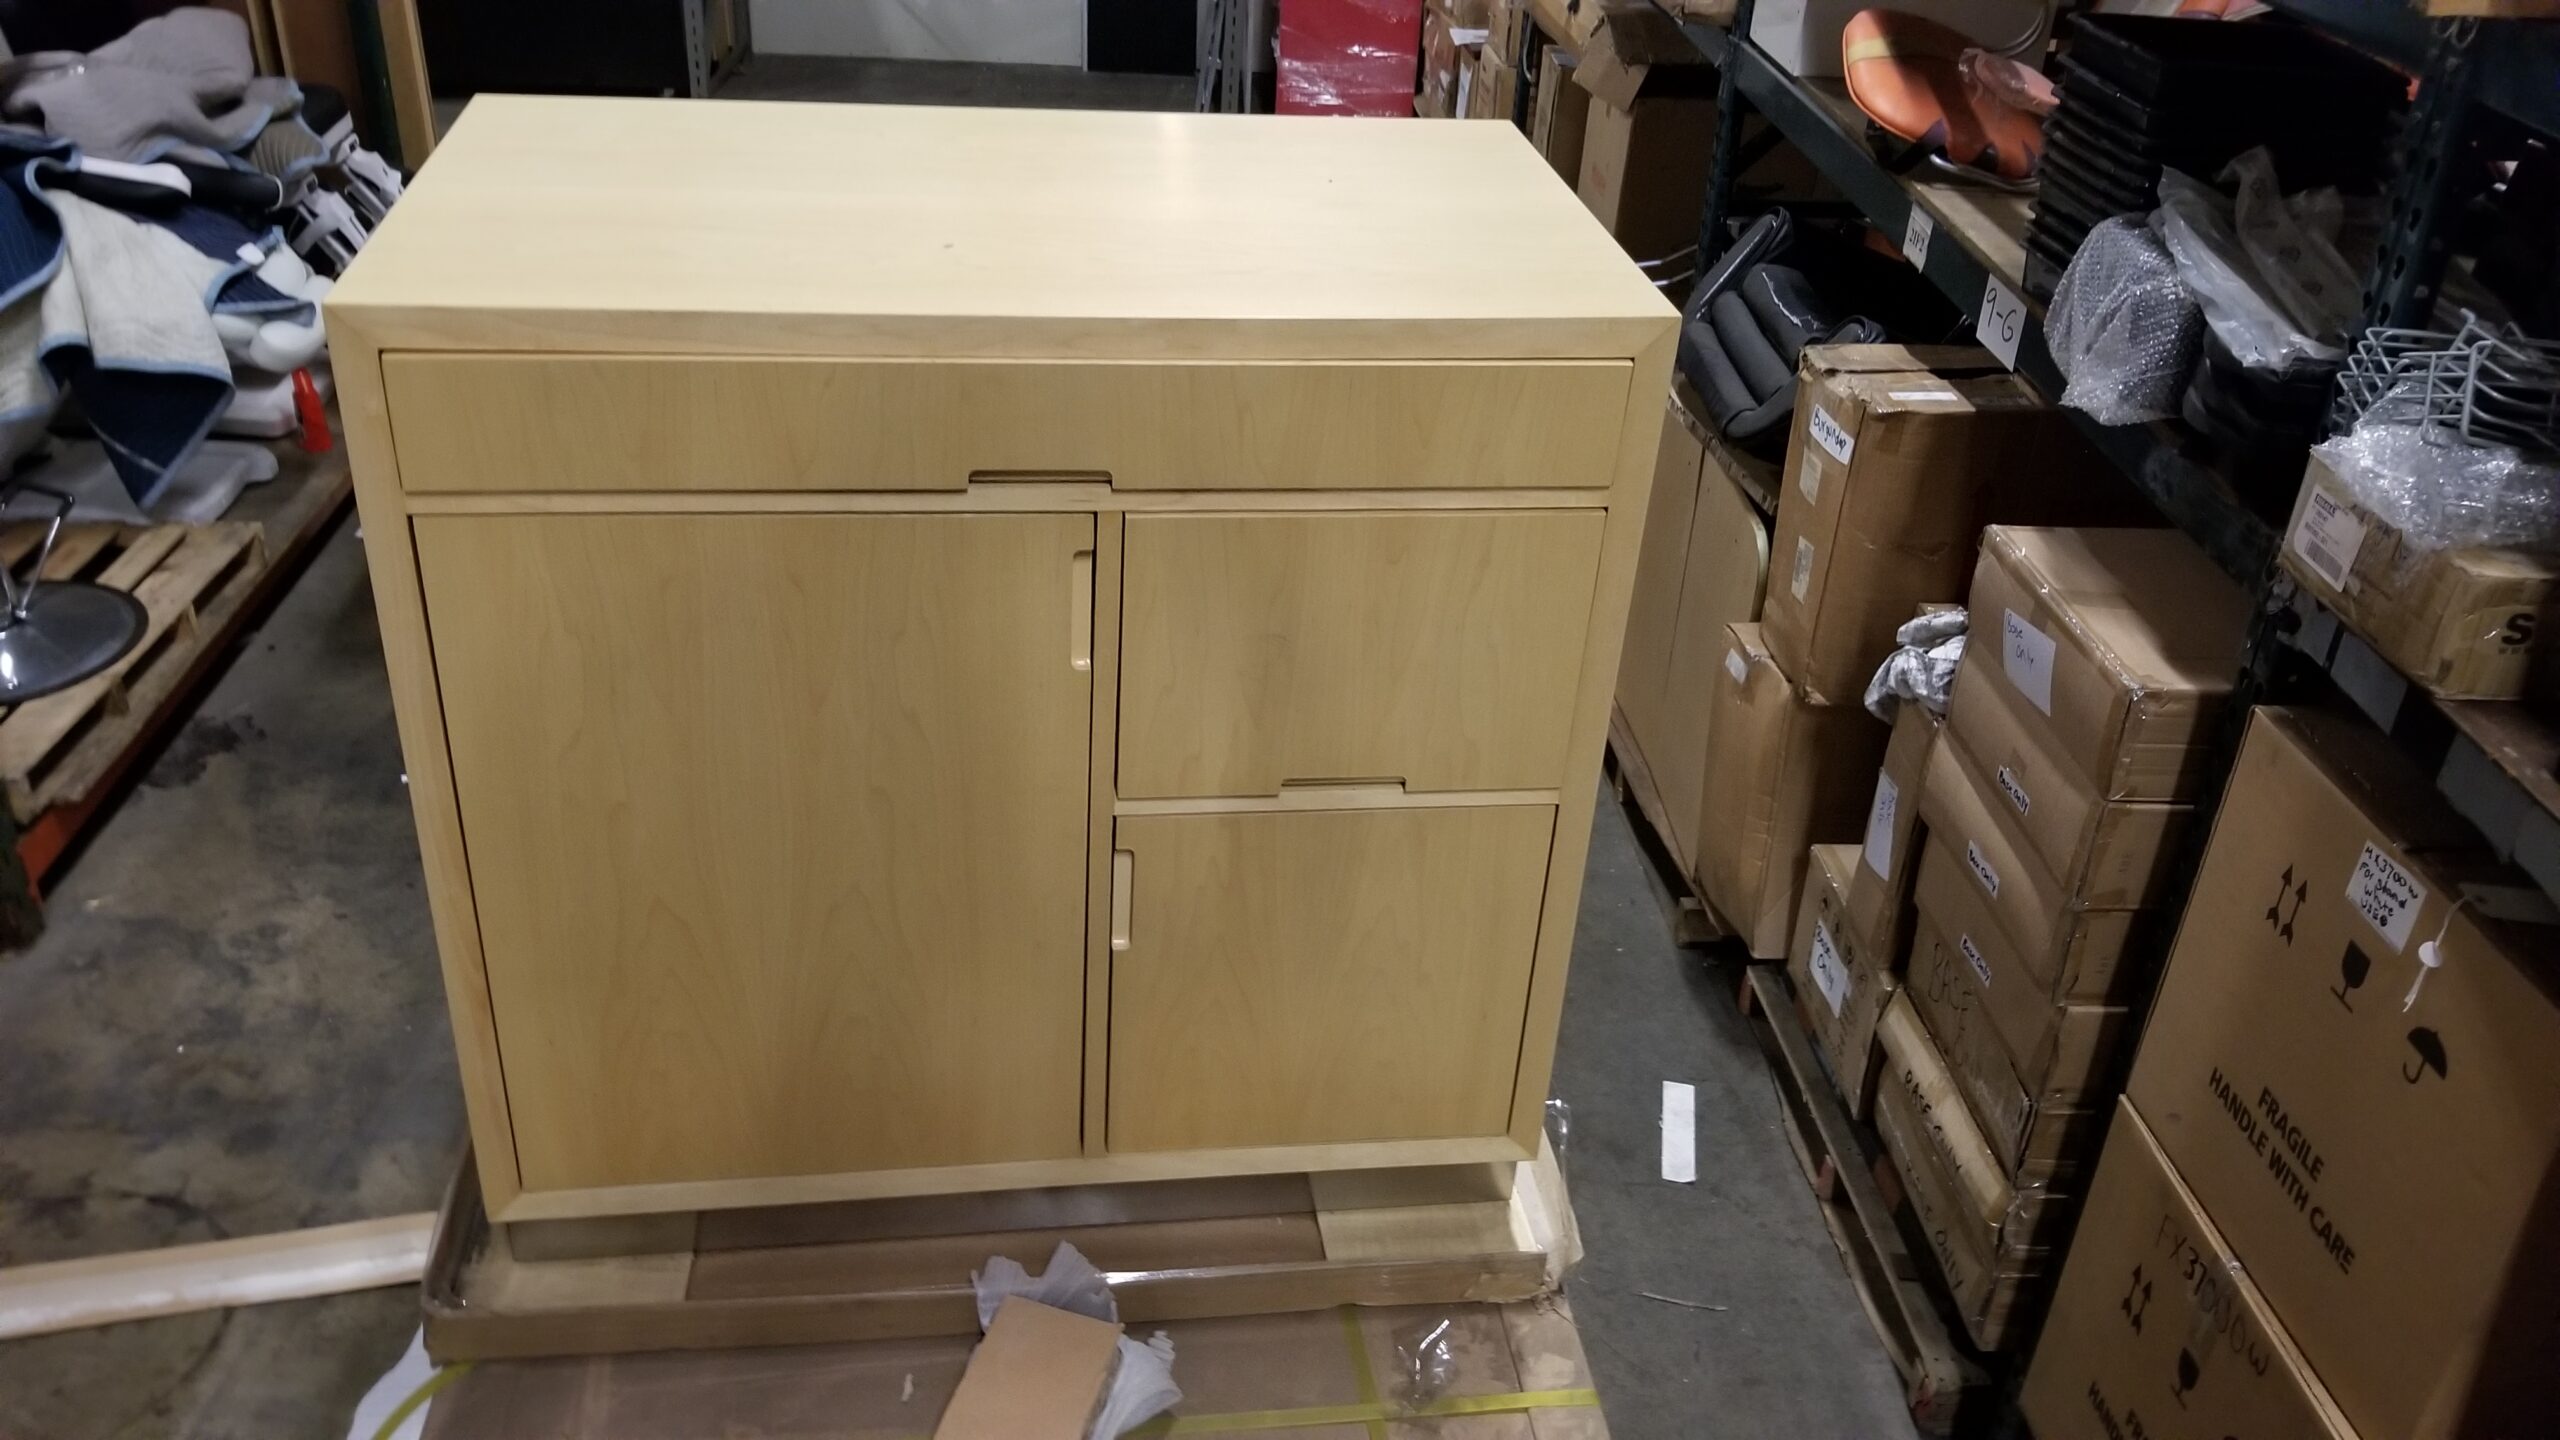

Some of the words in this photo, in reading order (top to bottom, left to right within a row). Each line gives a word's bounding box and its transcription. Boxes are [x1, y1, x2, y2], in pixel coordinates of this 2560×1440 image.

[2501, 612, 2536, 646] S
[2208, 1066, 2270, 1158] HANDLE
[2268, 1147, 2310, 1213] WITH
[2309, 1206, 2356, 1276] CARE
[2258, 1086, 2325, 1183] FRAGILE
